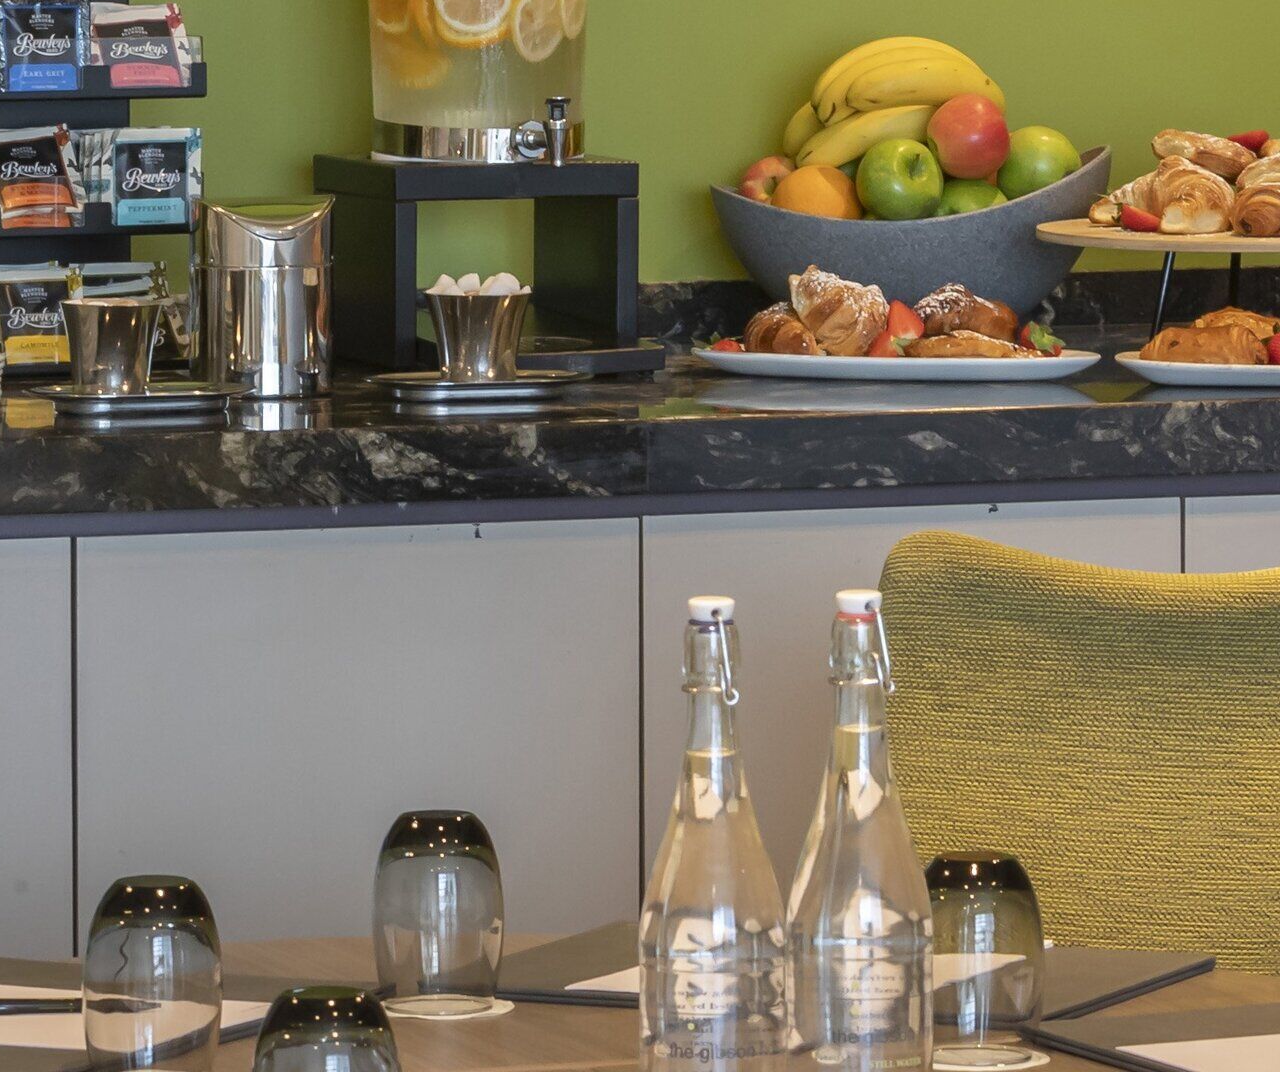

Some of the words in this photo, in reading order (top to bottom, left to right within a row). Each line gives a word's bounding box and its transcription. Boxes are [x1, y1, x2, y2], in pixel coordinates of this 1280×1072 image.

[13, 32, 71, 56] Bewley's
[110, 41, 169, 59] Bewley's
[46, 69, 65, 77] GREY
[0, 161, 58, 179] Bewley's
[122, 167, 181, 192] Bewley's
[128, 204, 178, 213] PEPPERMINT
[7, 306, 64, 329] Bewley's
[669, 1040, 694, 1059] the
